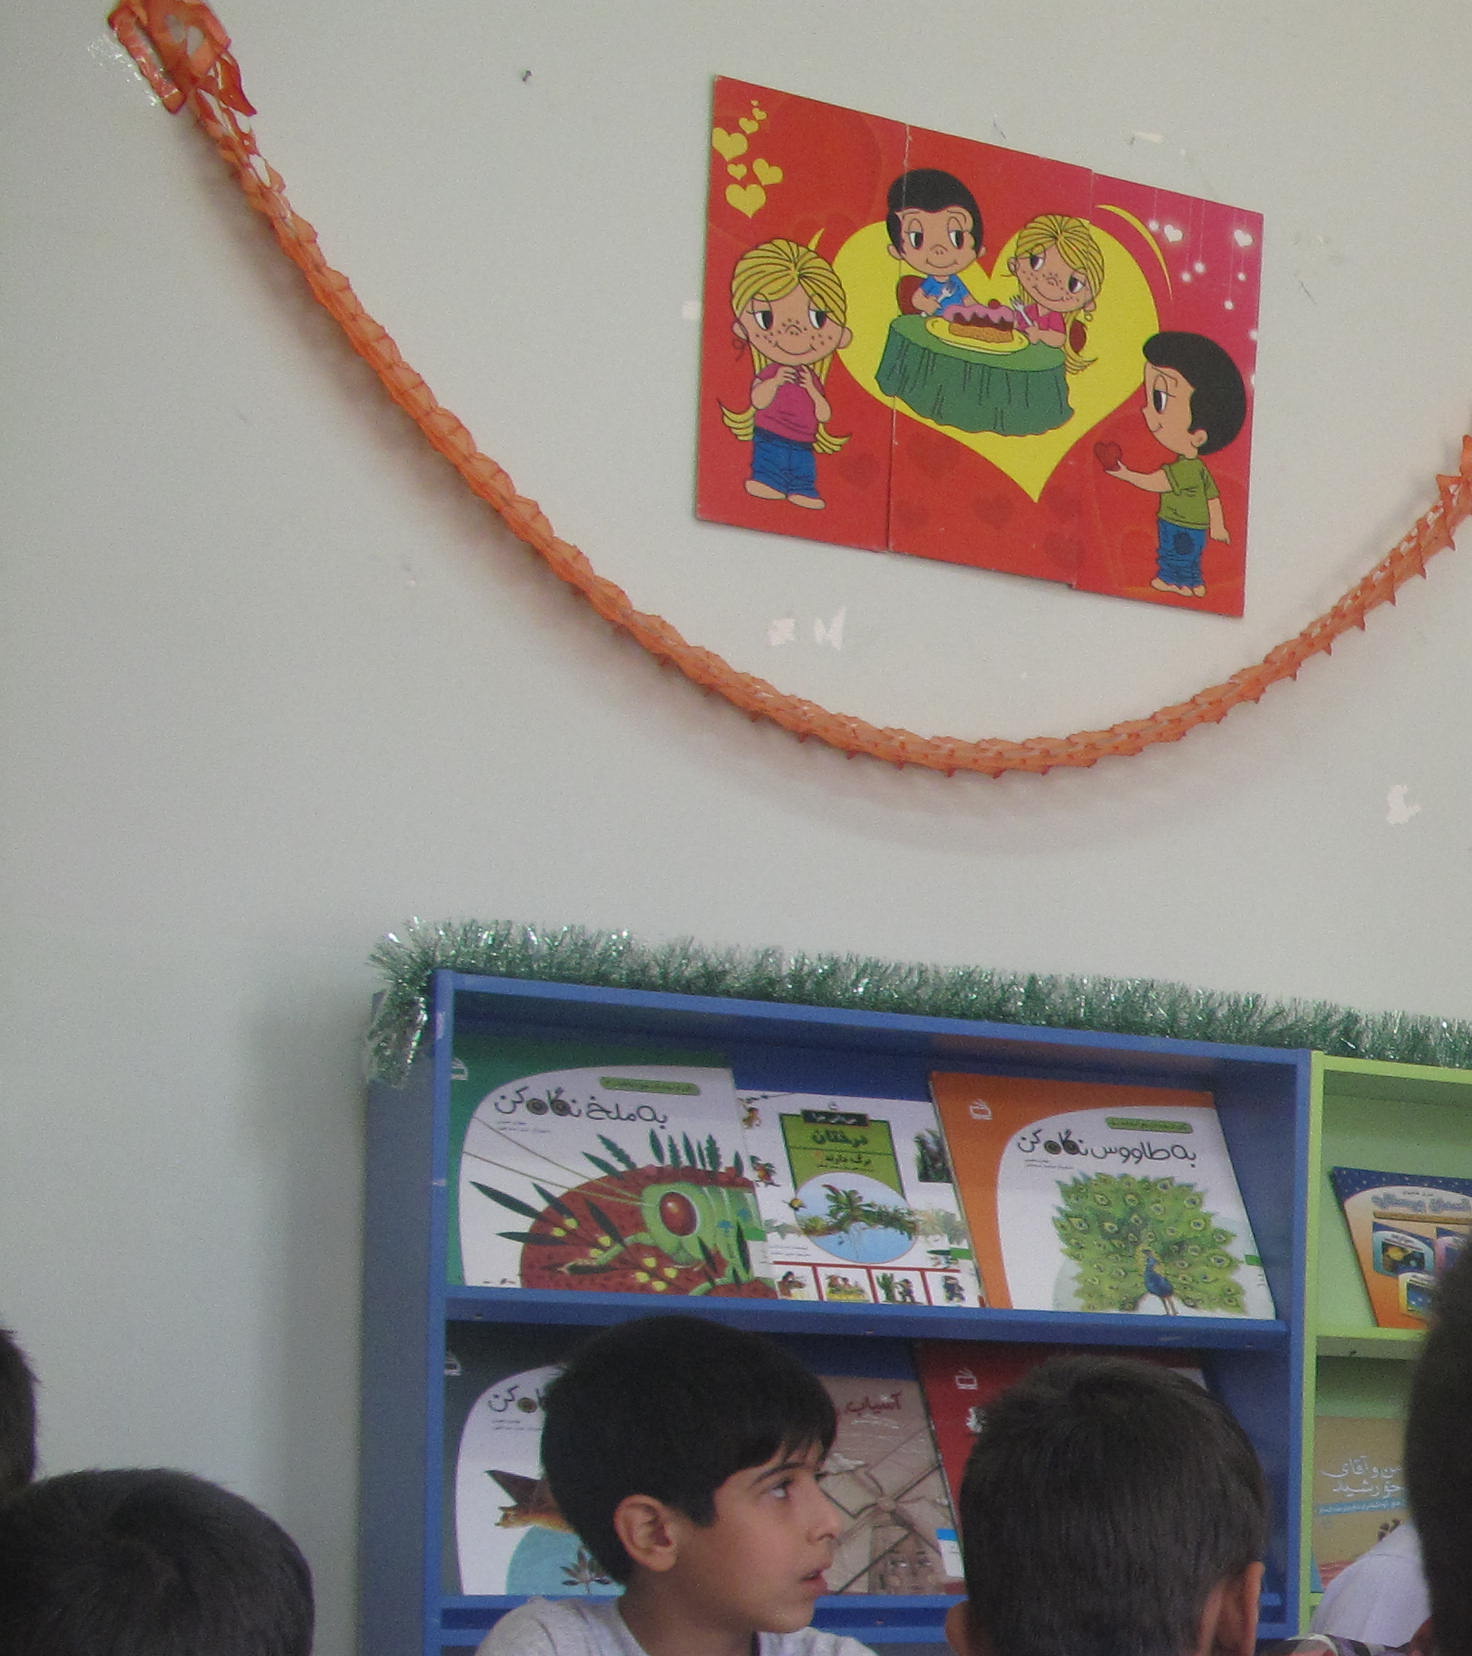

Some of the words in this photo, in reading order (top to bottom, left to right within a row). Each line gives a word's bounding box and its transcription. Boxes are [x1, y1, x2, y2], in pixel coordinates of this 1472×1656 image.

[494, 1086, 529, 1115] کن
[586, 1095, 637, 1122] ملخ
[636, 1105, 668, 1130] به
[1017, 1128, 1044, 1153] کن
[1090, 1141, 1172, 1165] طاووس
[1171, 1144, 1198, 1168] به
[487, 1385, 521, 1412] کن
